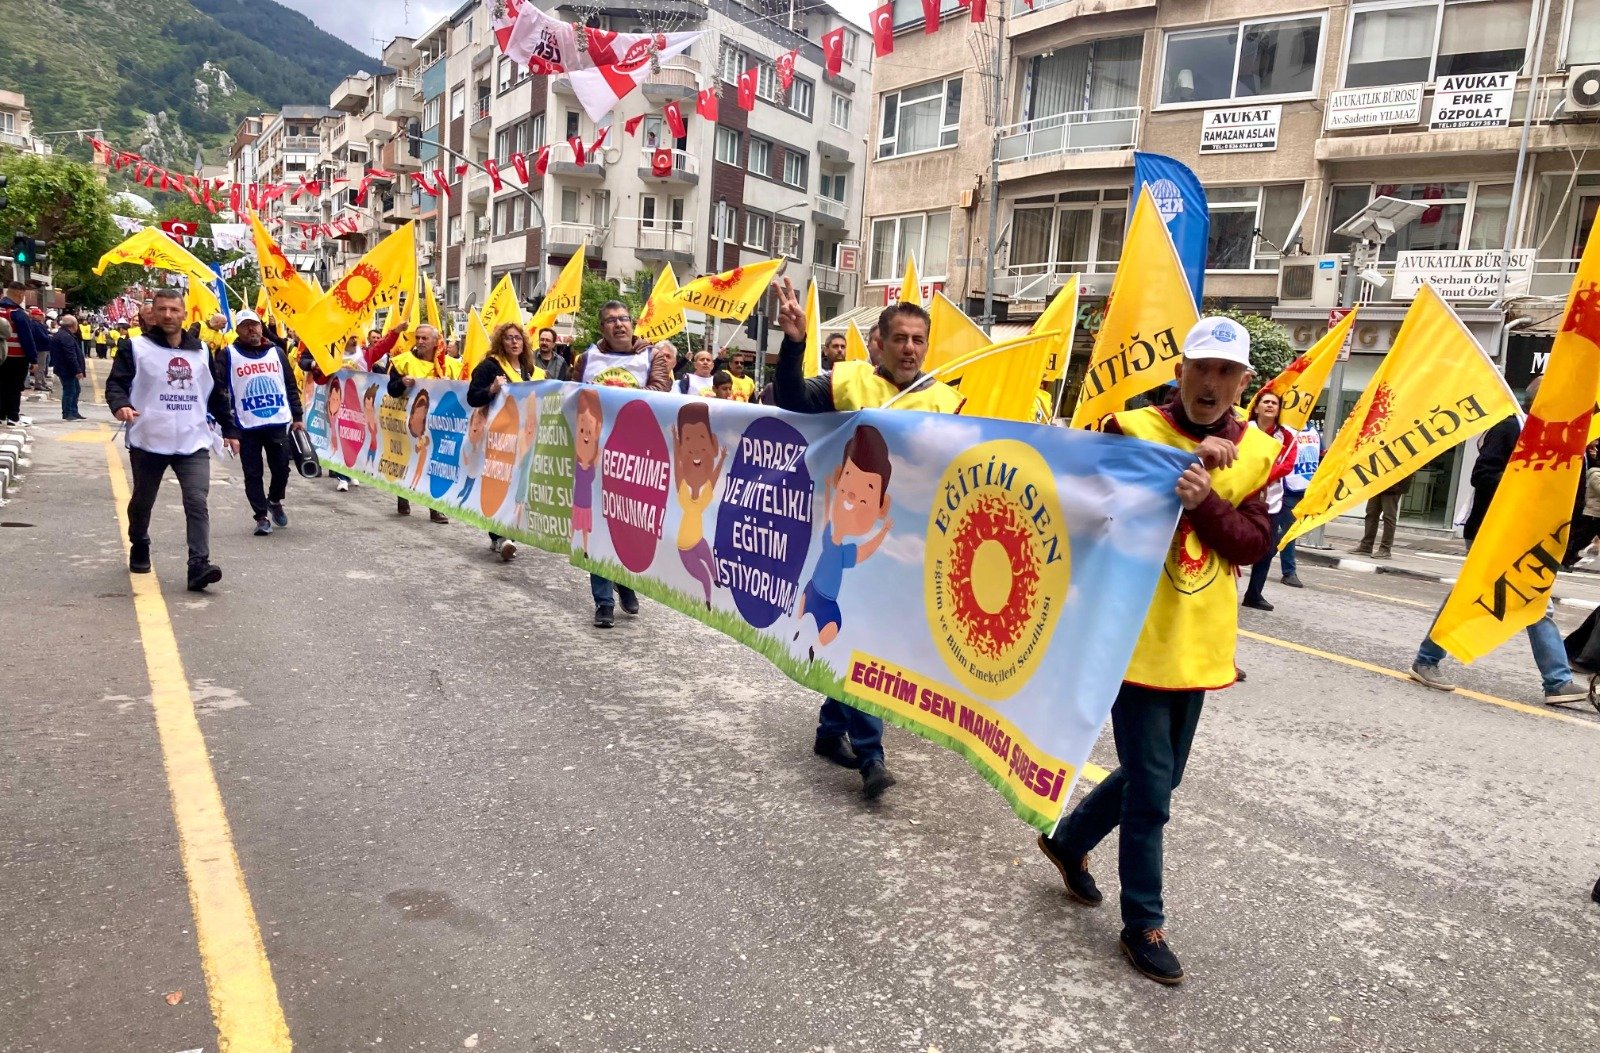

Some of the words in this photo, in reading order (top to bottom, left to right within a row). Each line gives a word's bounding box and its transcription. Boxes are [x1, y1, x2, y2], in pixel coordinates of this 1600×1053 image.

[1443, 75, 1509, 90] AVUKAT
[1332, 91, 1382, 108] AVUKATLIK
[1383, 88, 1419, 104] BÜROSU
[1452, 93, 1493, 105] EMRE
[1212, 110, 1272, 124] AVUKAT
[1331, 112, 1378, 125] Av.Sadettin
[1380, 109, 1416, 121] YILMAZ
[1438, 108, 1503, 120] ÖZPOLAT
[1204, 129, 1245, 141] RAMAZAN
[1246, 128, 1276, 139] ASLAN
[842, 250, 855, 268] E
[1401, 255, 1473, 268] AVUKATLIK
[1474, 252, 1528, 268] BÜRSU
[1430, 274, 1471, 284] Serhan
[888, 285, 929, 300] ECE
[1467, 286, 1498, 297] Özbe
[1211, 329, 1237, 341] KESK
[160, 394, 198, 402] DÜZENLEME
[240, 393, 285, 411] KESK
[742, 436, 807, 473] PARASIZ
[556, 457, 573, 478] VE
[603, 450, 670, 492] BEDENİME
[1294, 461, 1318, 475] KES
[530, 481, 555, 506] TEMİZ
[557, 487, 574, 508] SU
[723, 475, 745, 505] VE
[740, 474, 813, 523] NİTELİKLİ
[602, 490, 656, 533] DOKUNMA
[935, 455, 1018, 536] EĞİTİM
[1019, 483, 1062, 565] SEN
[732, 514, 788, 563] EĞİTİM
[935, 560, 943, 610] Eğitim
[940, 615, 948, 632] ve
[947, 635, 968, 668] Bilim
[969, 662, 1017, 686] Emekçileri
[1017, 596, 1051, 668] Sendikası
[851, 661, 918, 705] EĞİTİM
[919, 688, 956, 723] SEN
[958, 705, 1012, 762] MANİSA
[1008, 742, 1067, 803] ŞUBESİ
